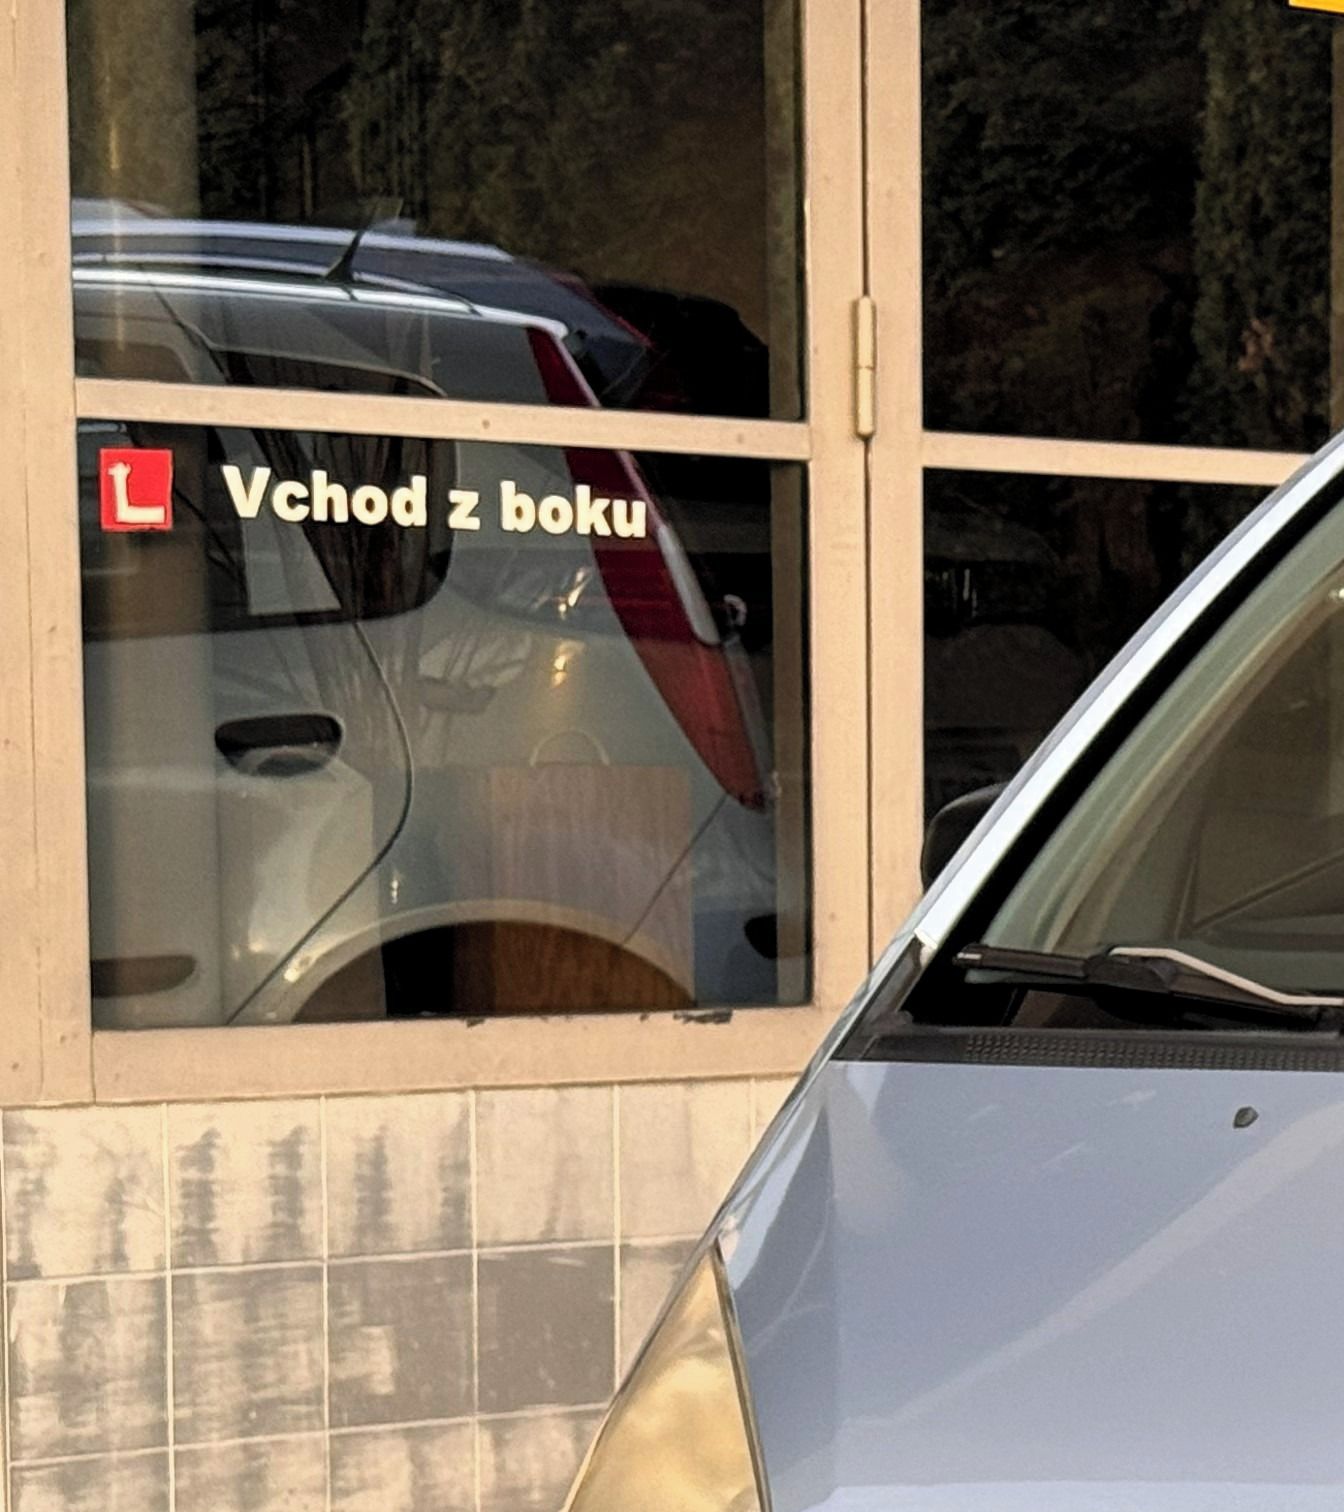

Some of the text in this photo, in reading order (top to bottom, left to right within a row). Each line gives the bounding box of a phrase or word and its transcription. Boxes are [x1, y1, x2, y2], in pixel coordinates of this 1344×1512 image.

[221, 465, 647, 538] Vchod z boku
